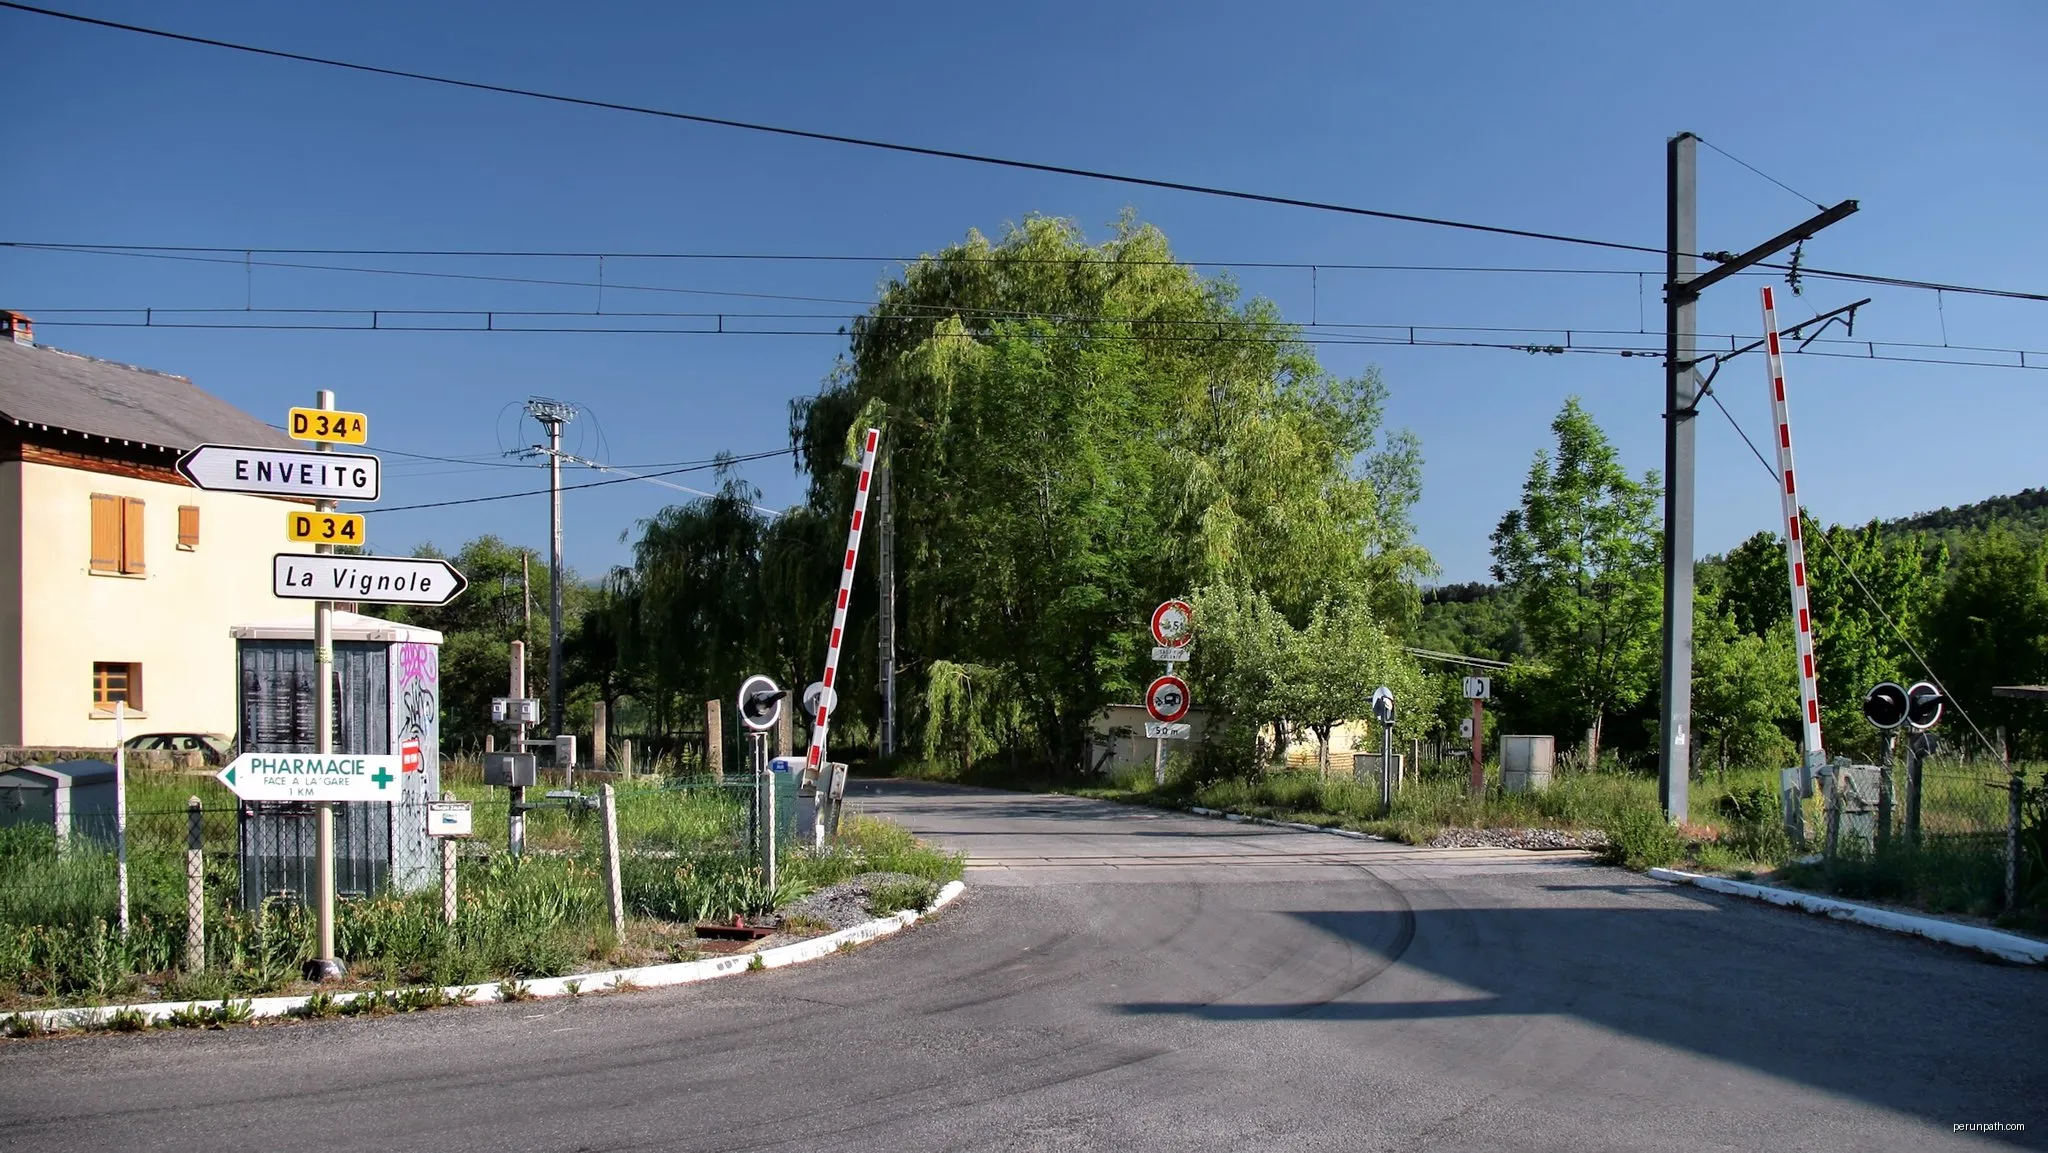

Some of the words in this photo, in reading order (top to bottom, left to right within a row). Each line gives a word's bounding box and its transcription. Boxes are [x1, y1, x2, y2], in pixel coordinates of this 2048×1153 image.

[293, 413, 308, 434] D
[235, 459, 367, 488] ENVEITG
[296, 516, 311, 537] D
[321, 518, 356, 540] 34
[285, 566, 314, 587] La
[332, 568, 432, 595] Vignole
[1156, 726, 1168, 735] 50
[251, 758, 365, 775] PHARMACIE
[263, 776, 286, 786] FACE
[323, 777, 350, 786] GARE
[297, 788, 314, 796] KM
